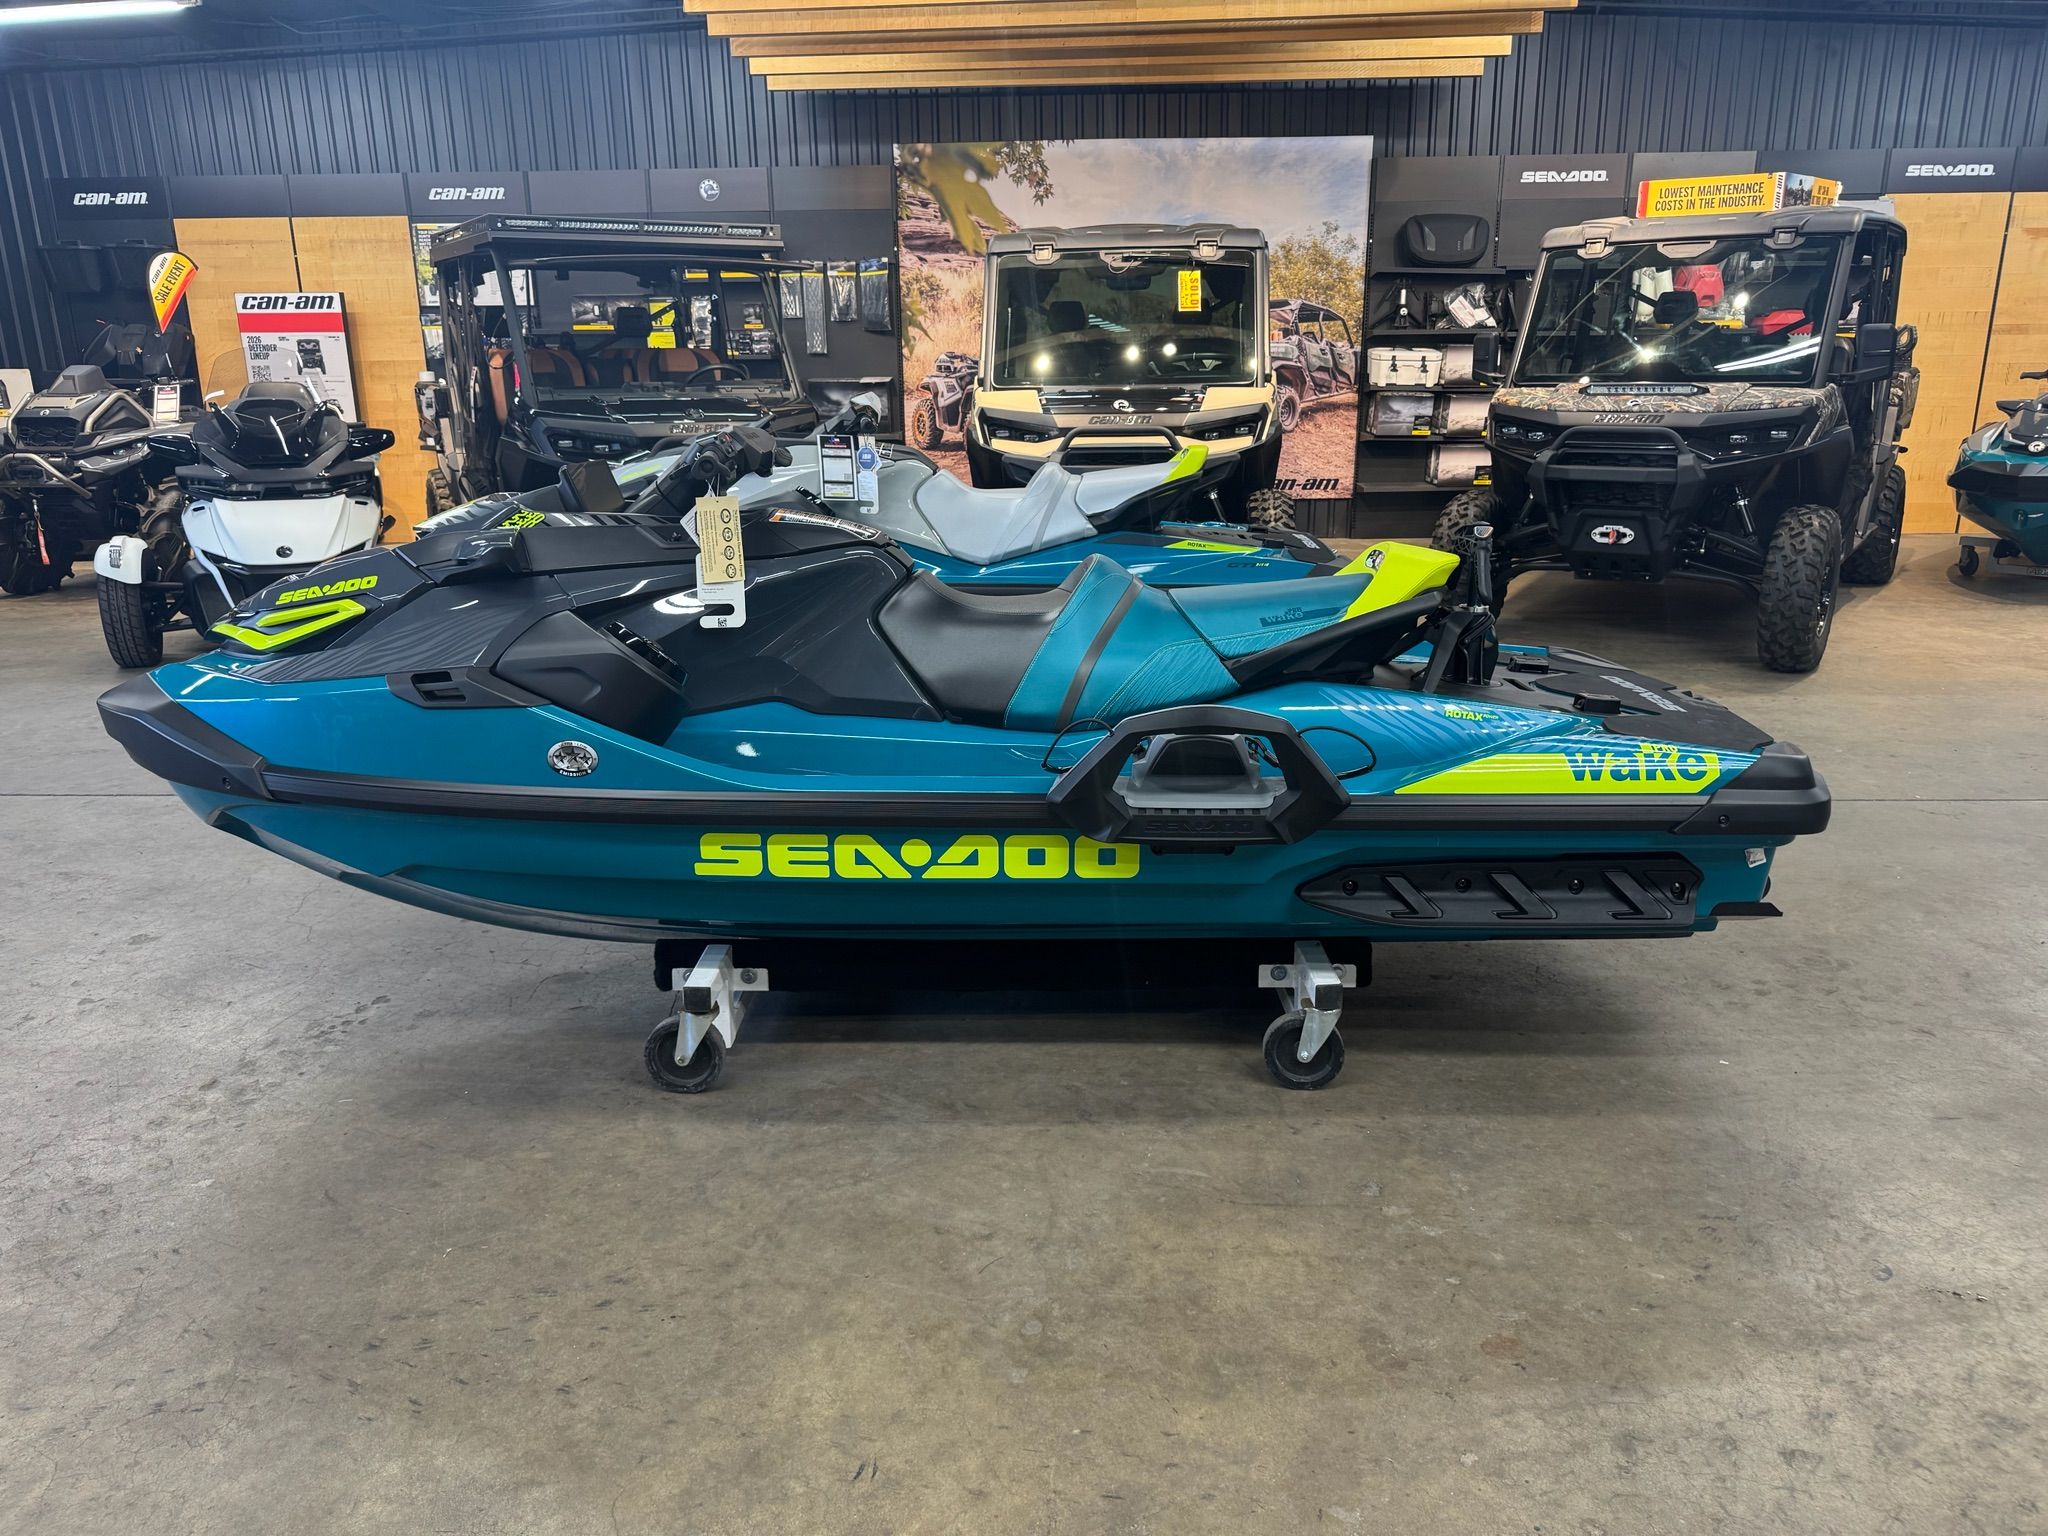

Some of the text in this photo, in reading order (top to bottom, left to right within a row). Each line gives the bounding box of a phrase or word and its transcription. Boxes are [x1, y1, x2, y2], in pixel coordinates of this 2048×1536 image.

[429, 187, 505, 200] can-am
[1659, 182, 1764, 199] LOWEST MAINTENANCE
[73, 192, 148, 205] can-am
[1655, 194, 1766, 211] COSTS IN THE INDUSTRY.
[155, 260, 186, 304] SALE EVENT
[241, 295, 335, 310] can-am
[246, 336, 262, 344] 2026
[248, 344, 277, 352] DEFENDER
[250, 352, 270, 360] LINEUP
[1273, 478, 1340, 490] an-am
[1445, 709, 1484, 722] ROTAX
